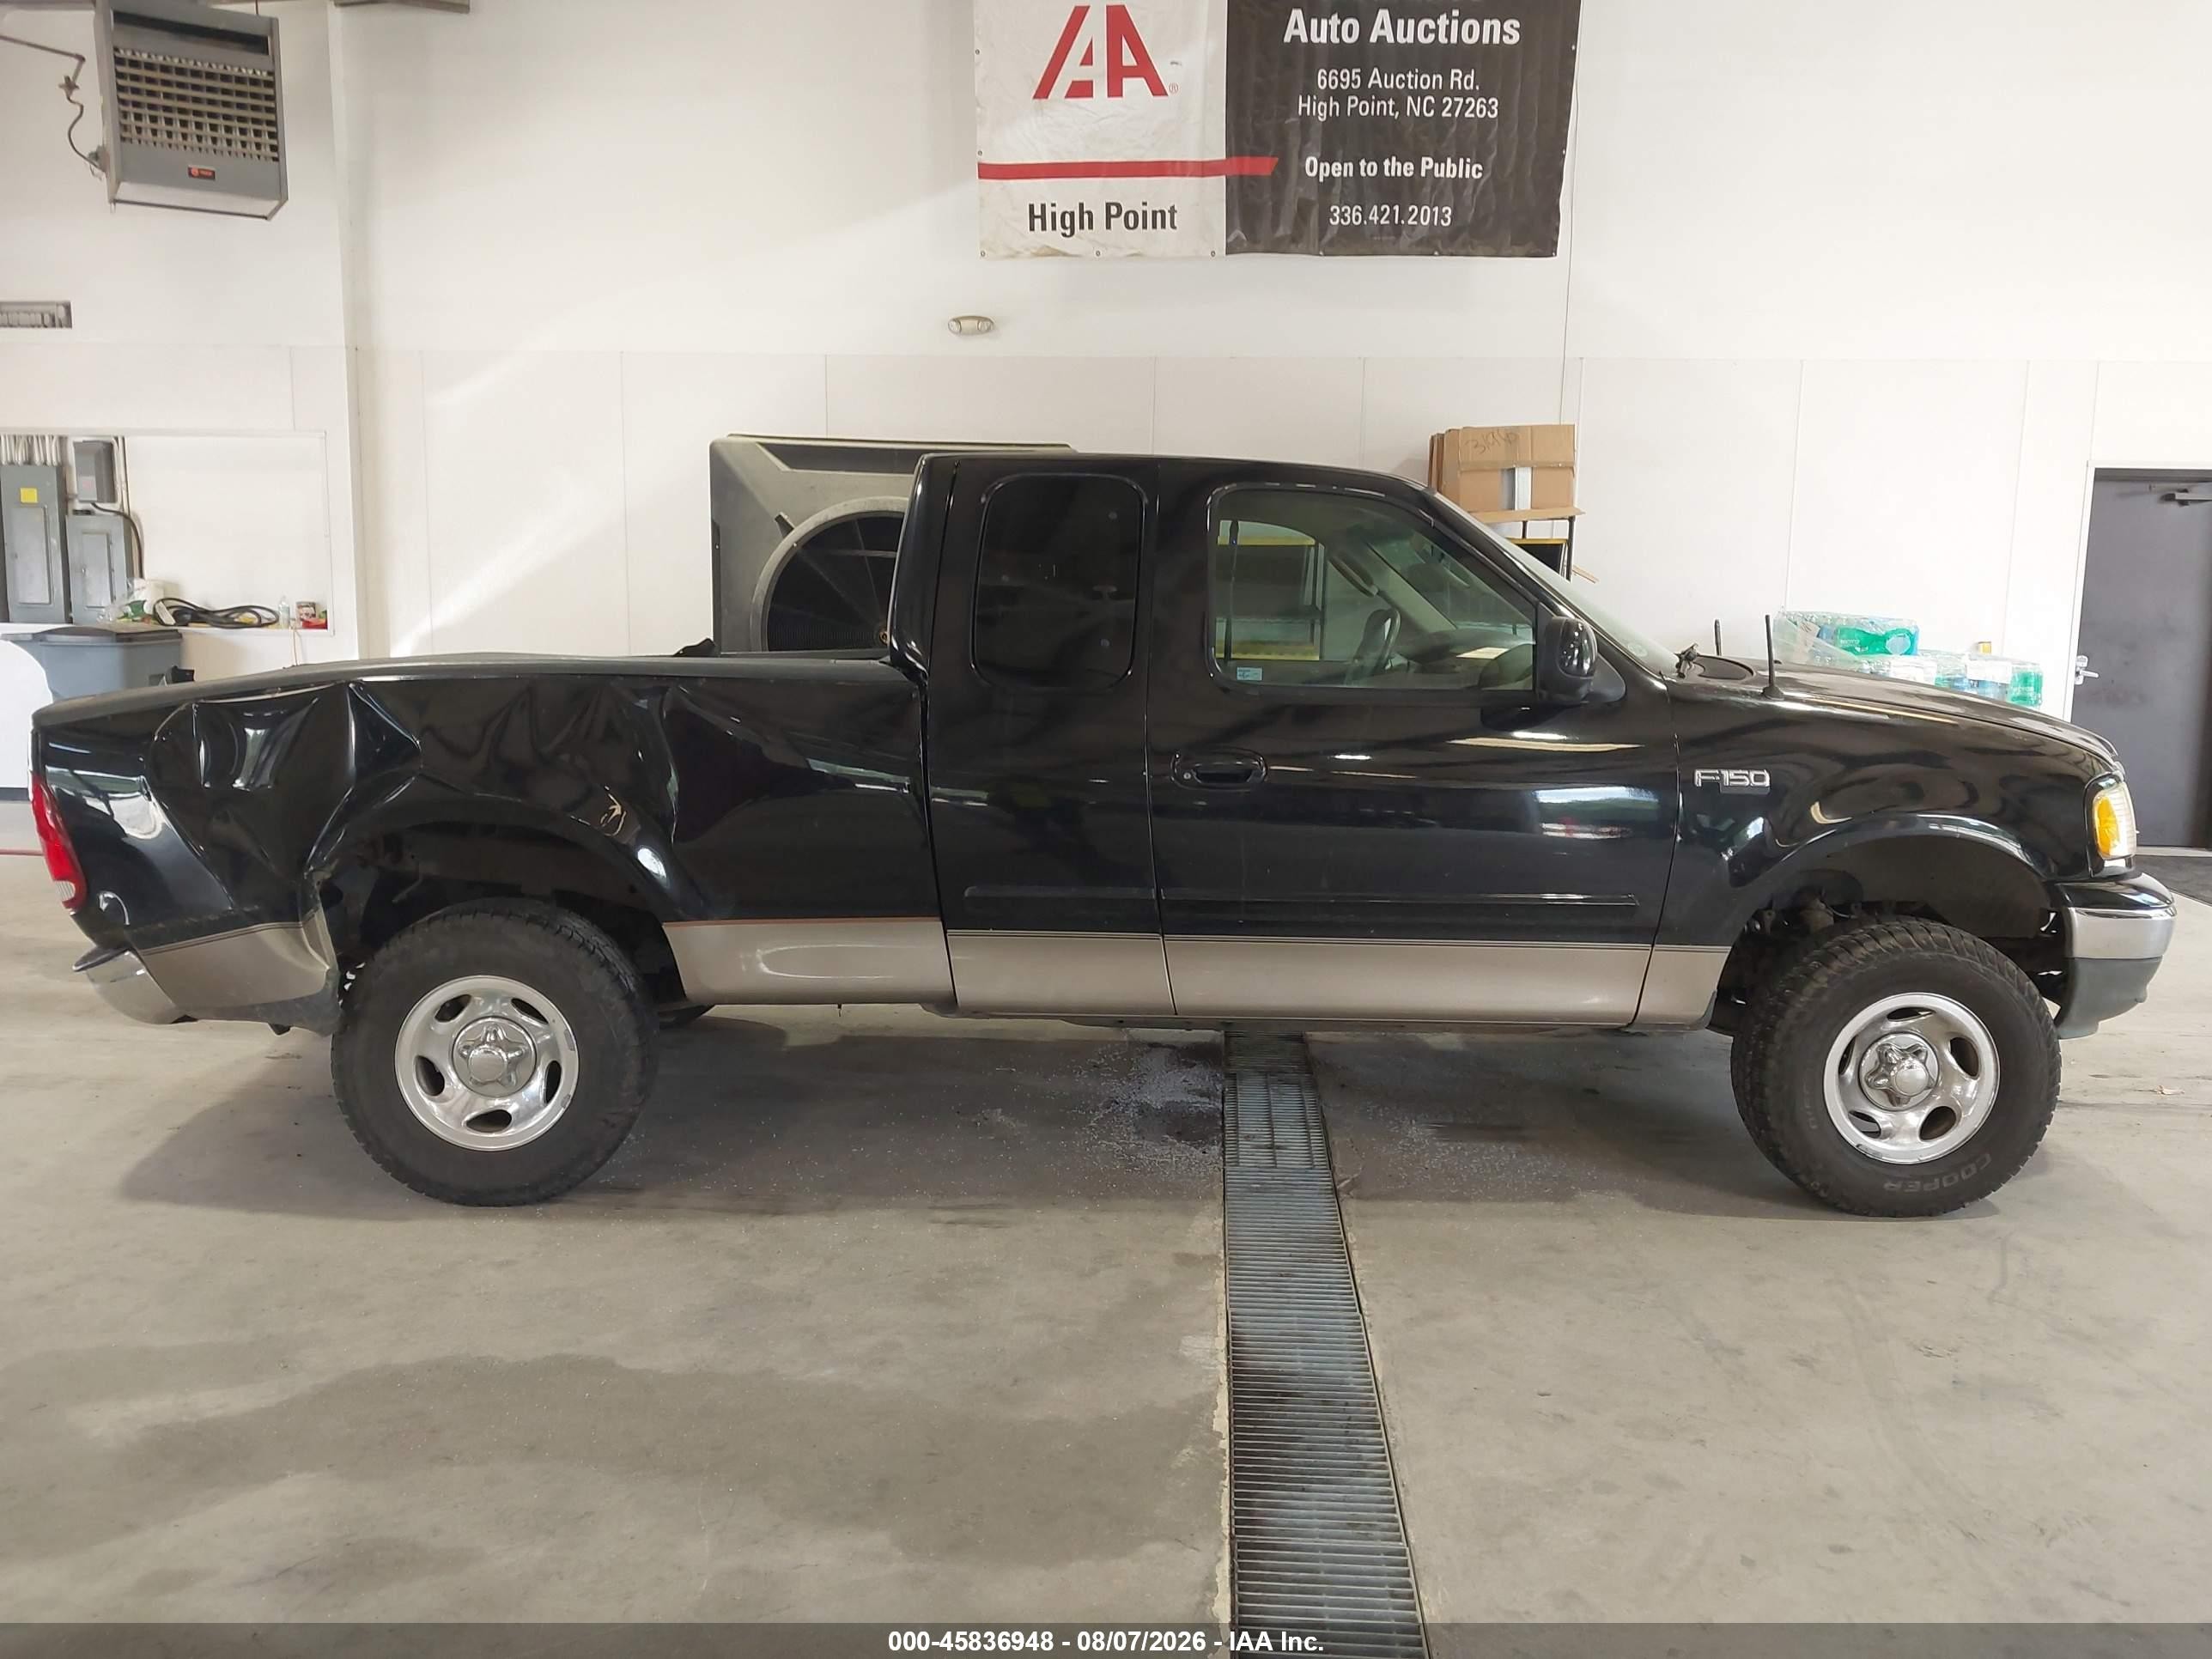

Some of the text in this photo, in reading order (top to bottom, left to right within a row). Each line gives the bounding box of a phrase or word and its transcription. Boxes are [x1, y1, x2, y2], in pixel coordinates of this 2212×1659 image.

[1283, 9, 1521, 45] Auto Auctions
[1317, 67, 1480, 91] 6695 Auction Rd.
[1297, 94, 1498, 122] High Point, NC 27263
[1304, 155, 1483, 183] Open to the Public
[1028, 201, 1178, 239] High Point
[1329, 204, 1452, 227] 336.421.2013
[1882, 1152, 1992, 1193] COOPER
